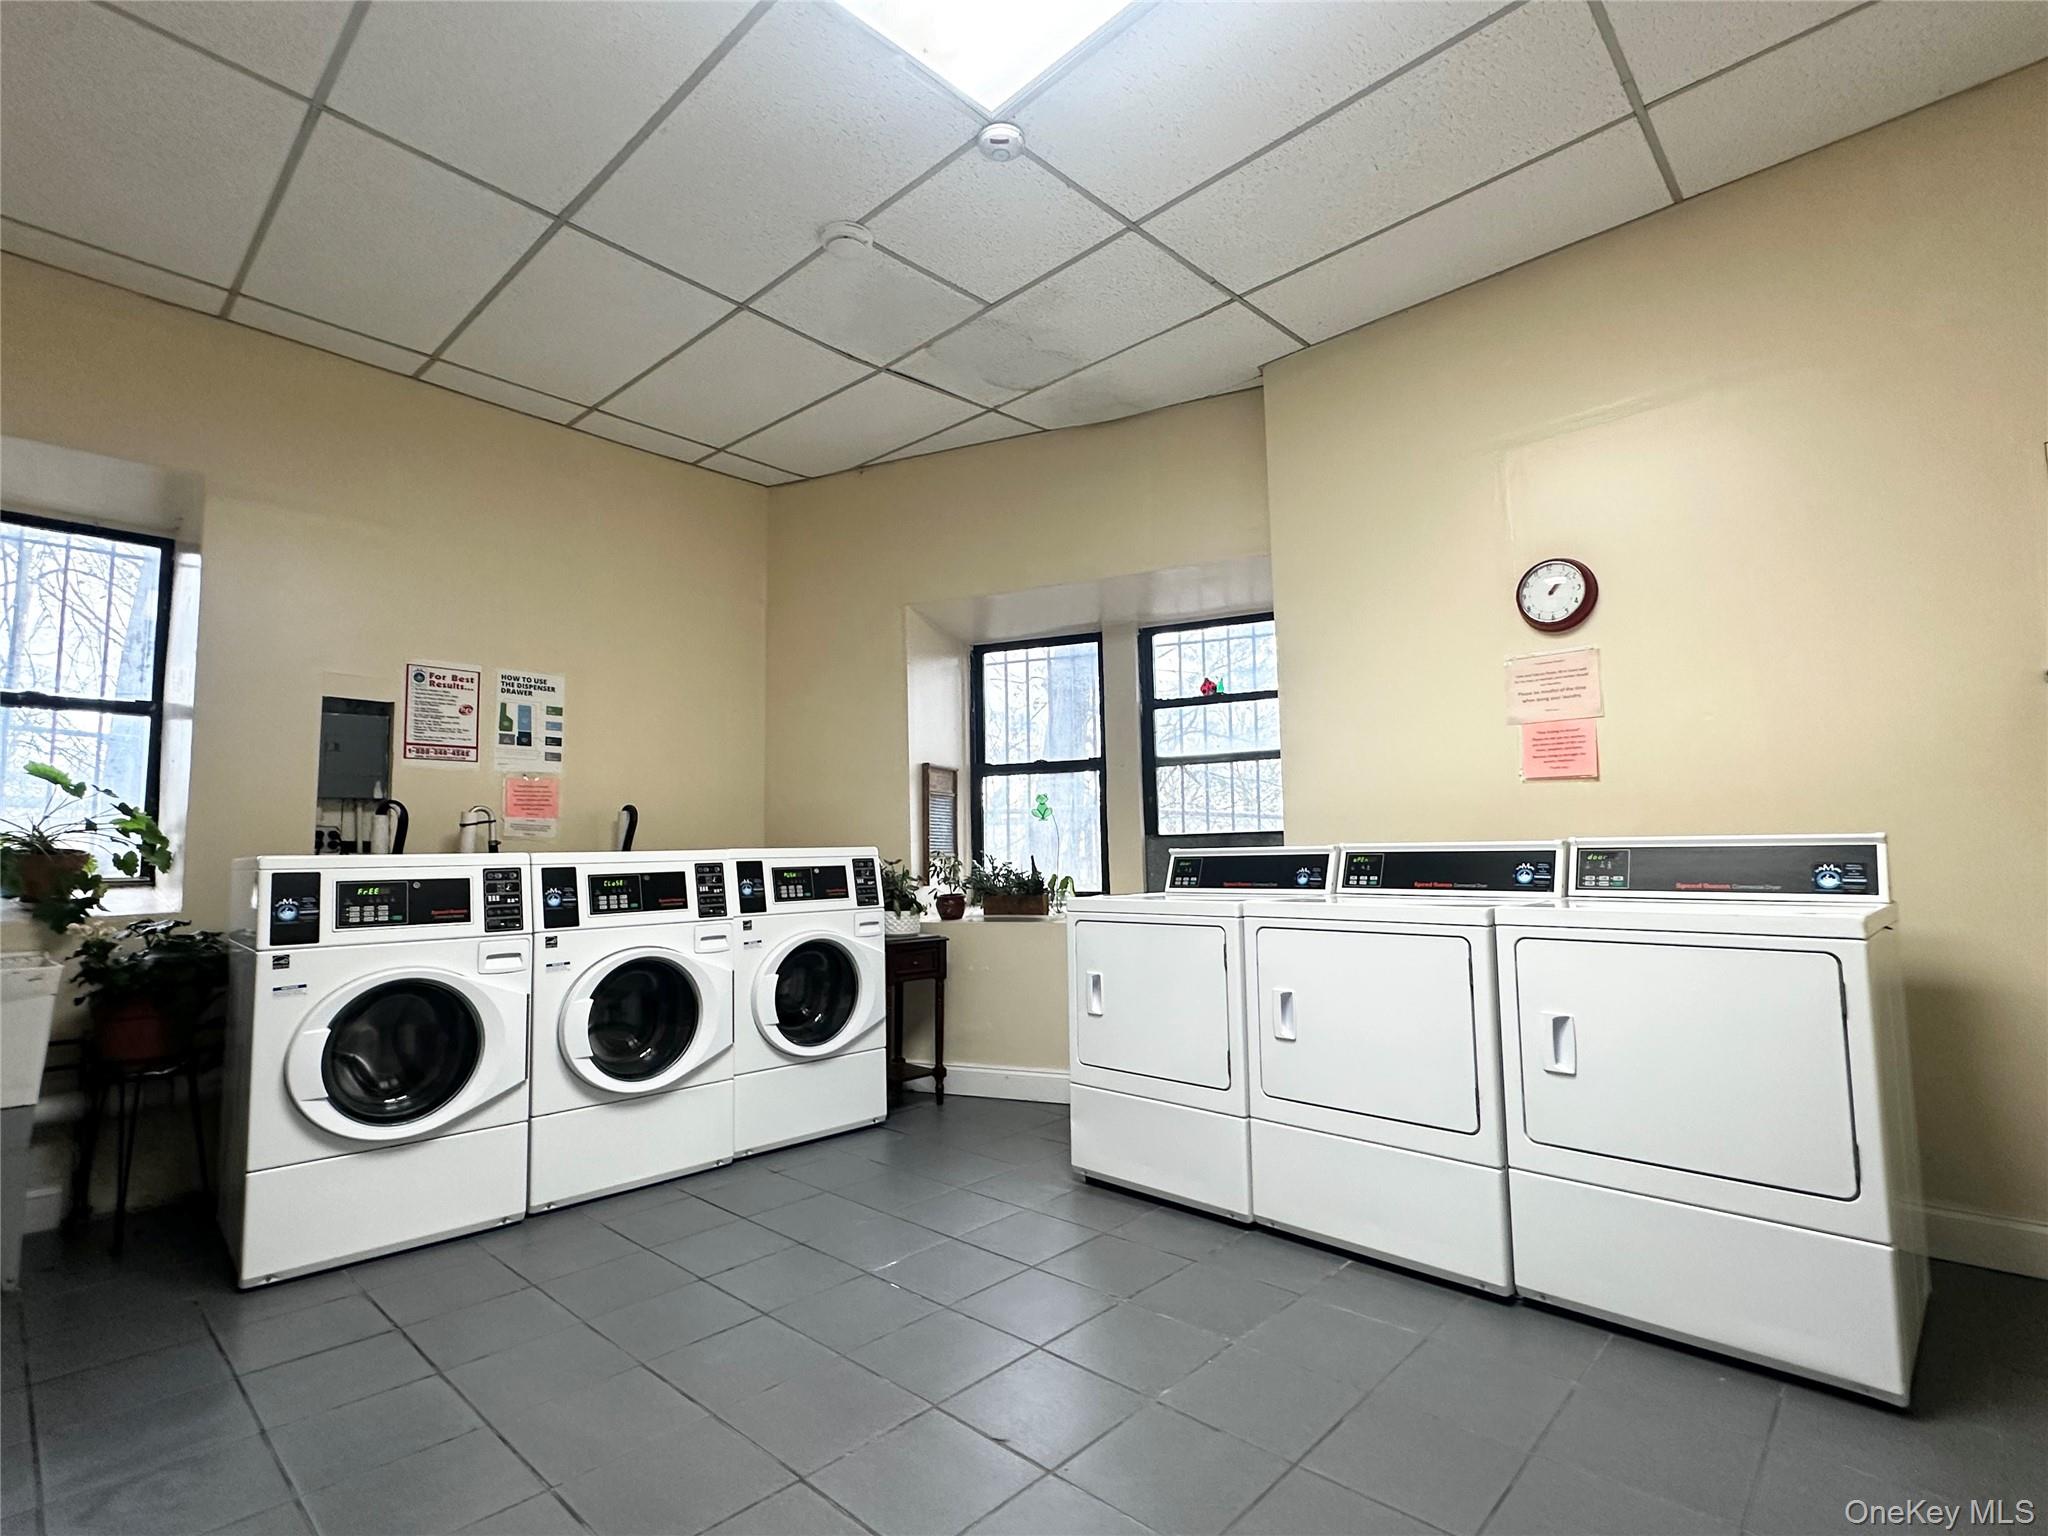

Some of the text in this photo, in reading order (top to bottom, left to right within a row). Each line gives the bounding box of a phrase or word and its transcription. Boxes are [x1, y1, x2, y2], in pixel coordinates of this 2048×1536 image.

[429, 672, 474, 684] For Best
[429, 680, 474, 691] Results...
[517, 683, 556, 693] DISPENSER
[500, 688, 533, 697] DRAWER
